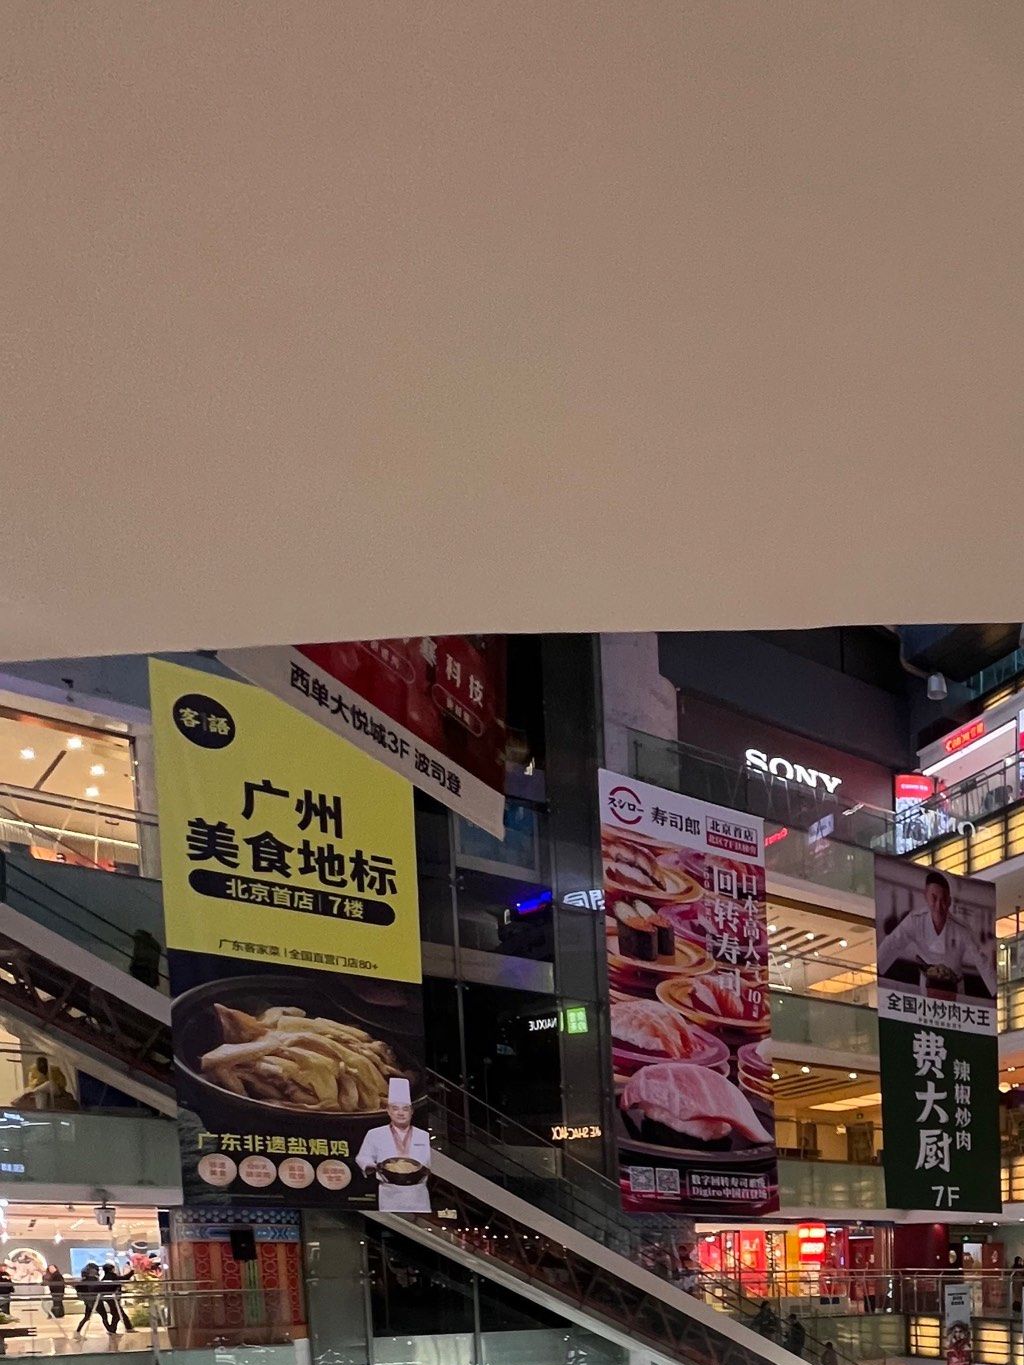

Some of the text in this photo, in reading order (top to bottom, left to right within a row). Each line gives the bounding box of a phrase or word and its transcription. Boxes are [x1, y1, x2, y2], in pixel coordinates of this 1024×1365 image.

[289, 660, 462, 798] 西单大悦城3F 波司登
[745, 749, 842, 794] SONY
[241, 780, 343, 839] 广州
[608, 797, 645, 812] スシロー
[651, 807, 701, 836] 寿司郎
[710, 820, 753, 842] 北京首店
[186, 818, 398, 896] 美食地标
[226, 878, 364, 920] 北京首店 7楼
[714, 866, 741, 999] 回转寿司
[887, 992, 990, 1027] 全国小炒肉大王
[913, 1030, 951, 1173] 费大厨
[953, 1059, 971, 1151] 辣椒炒肉
[198, 1132, 350, 1158] 广东非遗盐焗鸡
[931, 1186, 960, 1207] 7F
